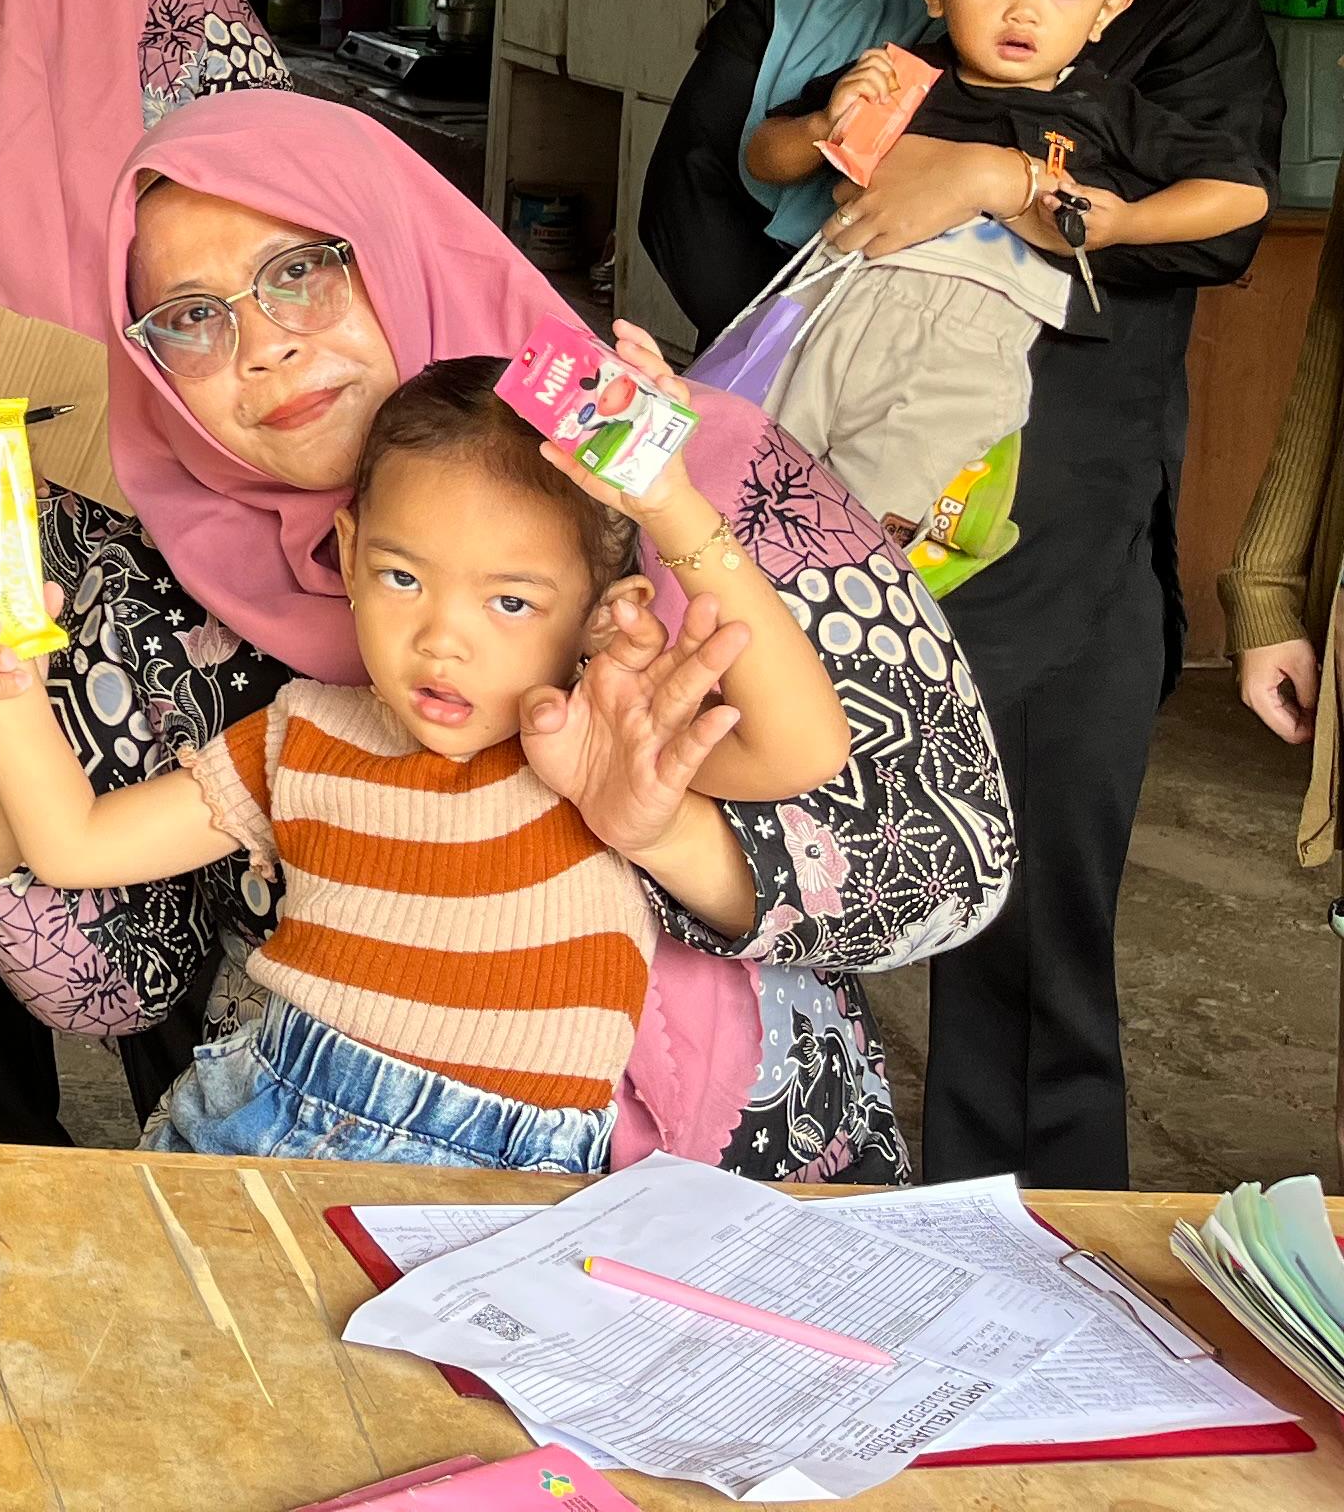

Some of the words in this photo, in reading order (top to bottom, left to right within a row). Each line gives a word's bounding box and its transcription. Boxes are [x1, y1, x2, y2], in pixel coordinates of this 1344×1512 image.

[534, 352, 577, 407] Milk
[949, 1379, 997, 1412] KARTU
[887, 1410, 961, 1455] KELUARGA
